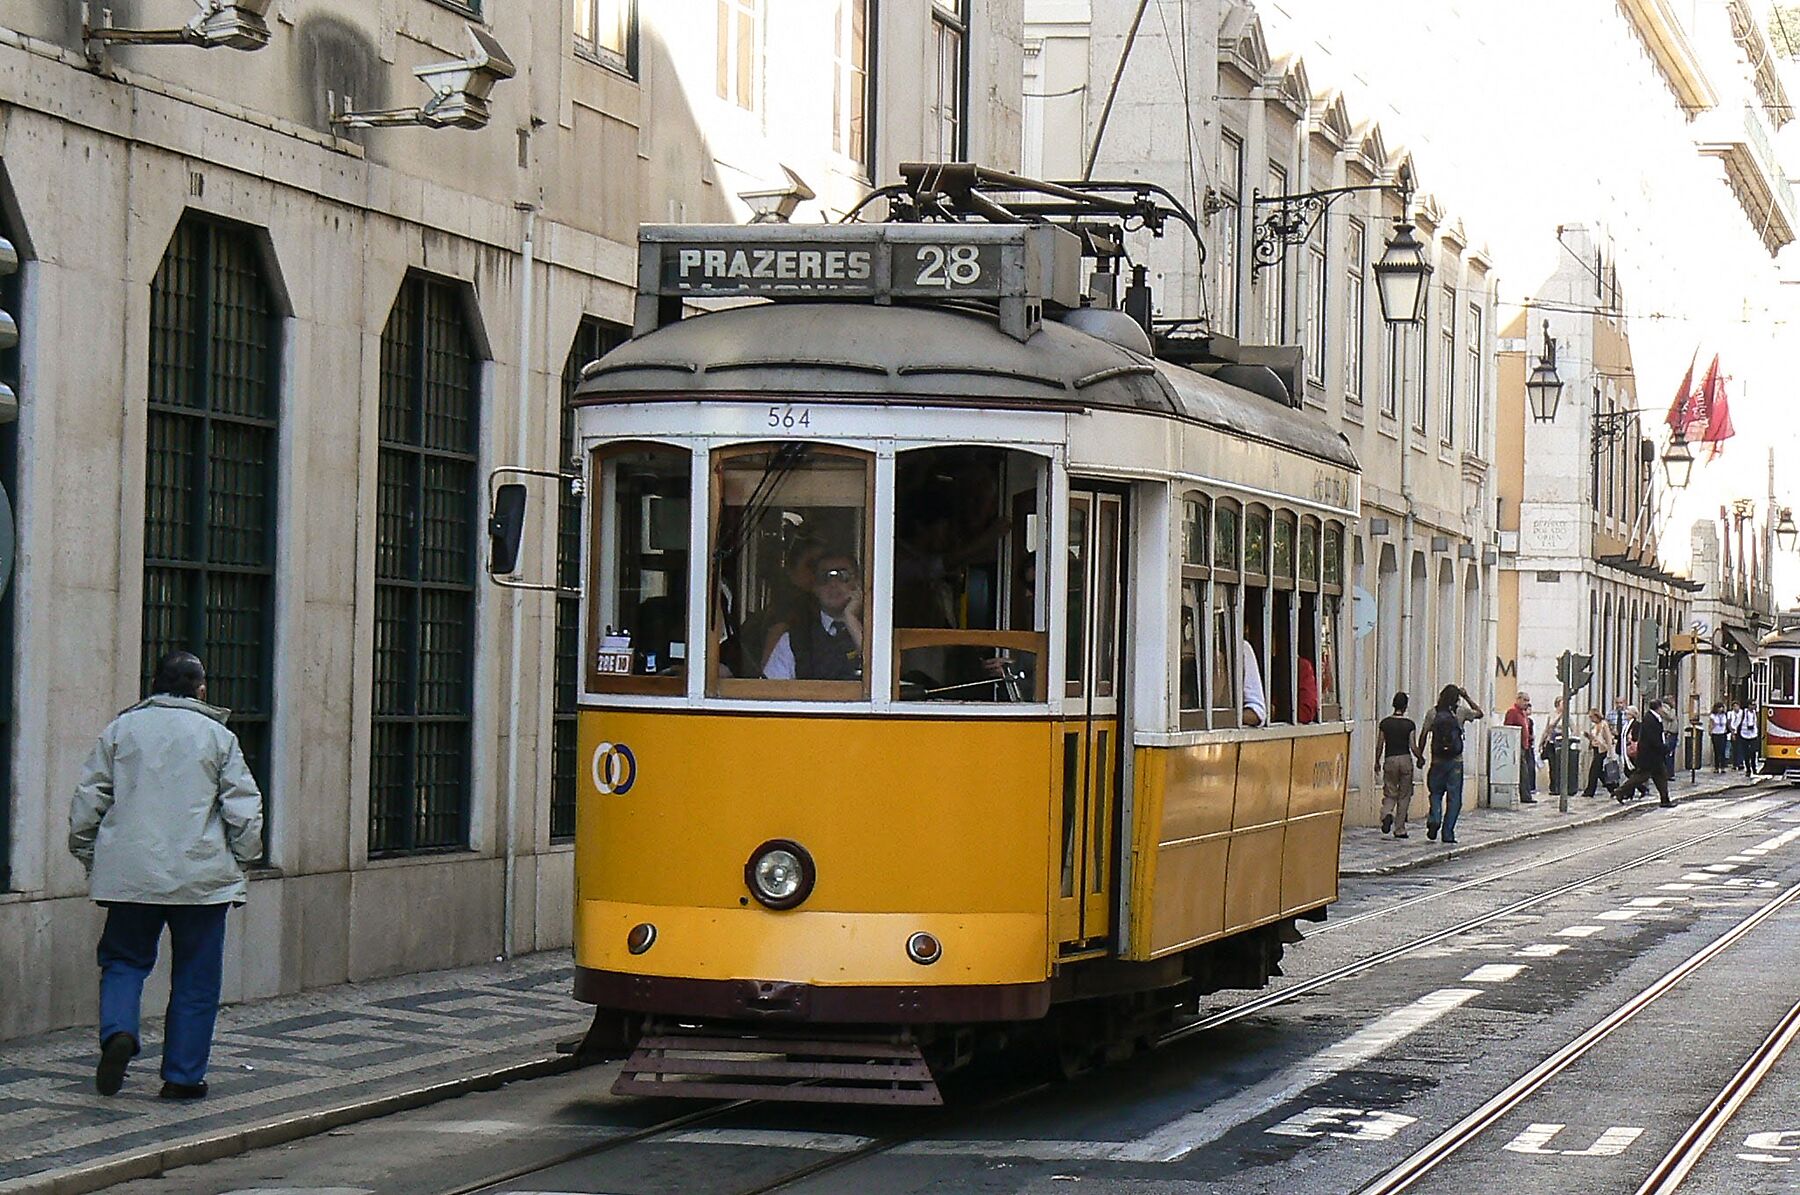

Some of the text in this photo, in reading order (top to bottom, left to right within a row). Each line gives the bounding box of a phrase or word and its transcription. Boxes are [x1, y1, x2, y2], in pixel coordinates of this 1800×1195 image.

[679, 249, 871, 280] PRAZERES
[915, 244, 981, 288] 28
[768, 407, 811, 428] 564
